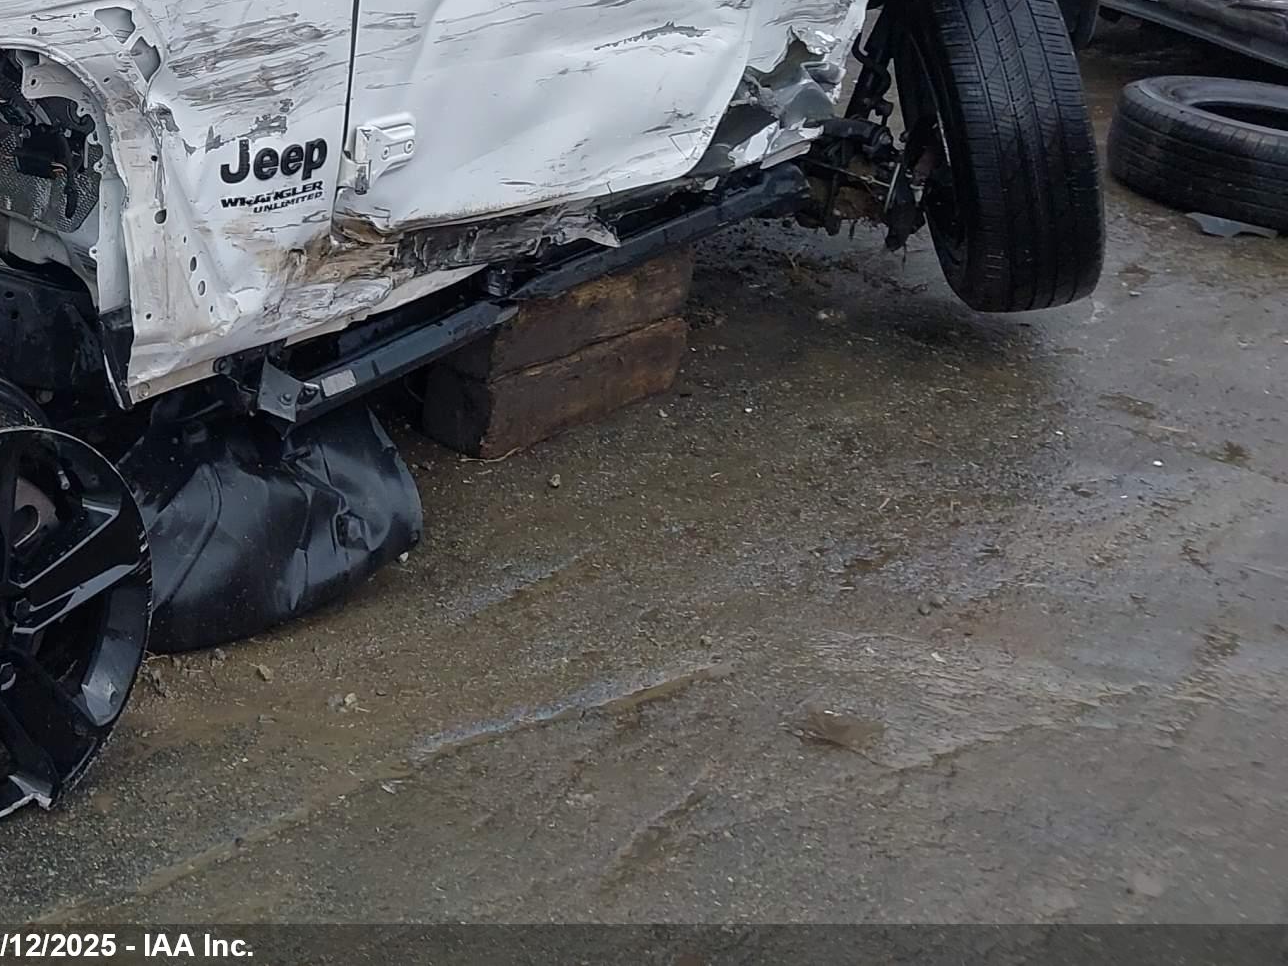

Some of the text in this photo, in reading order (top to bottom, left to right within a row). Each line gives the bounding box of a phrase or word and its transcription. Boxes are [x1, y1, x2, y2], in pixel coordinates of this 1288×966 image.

[220, 137, 328, 183] Jeep
[220, 180, 324, 208] WRANGLER
[253, 191, 323, 213] UNLIMITED
